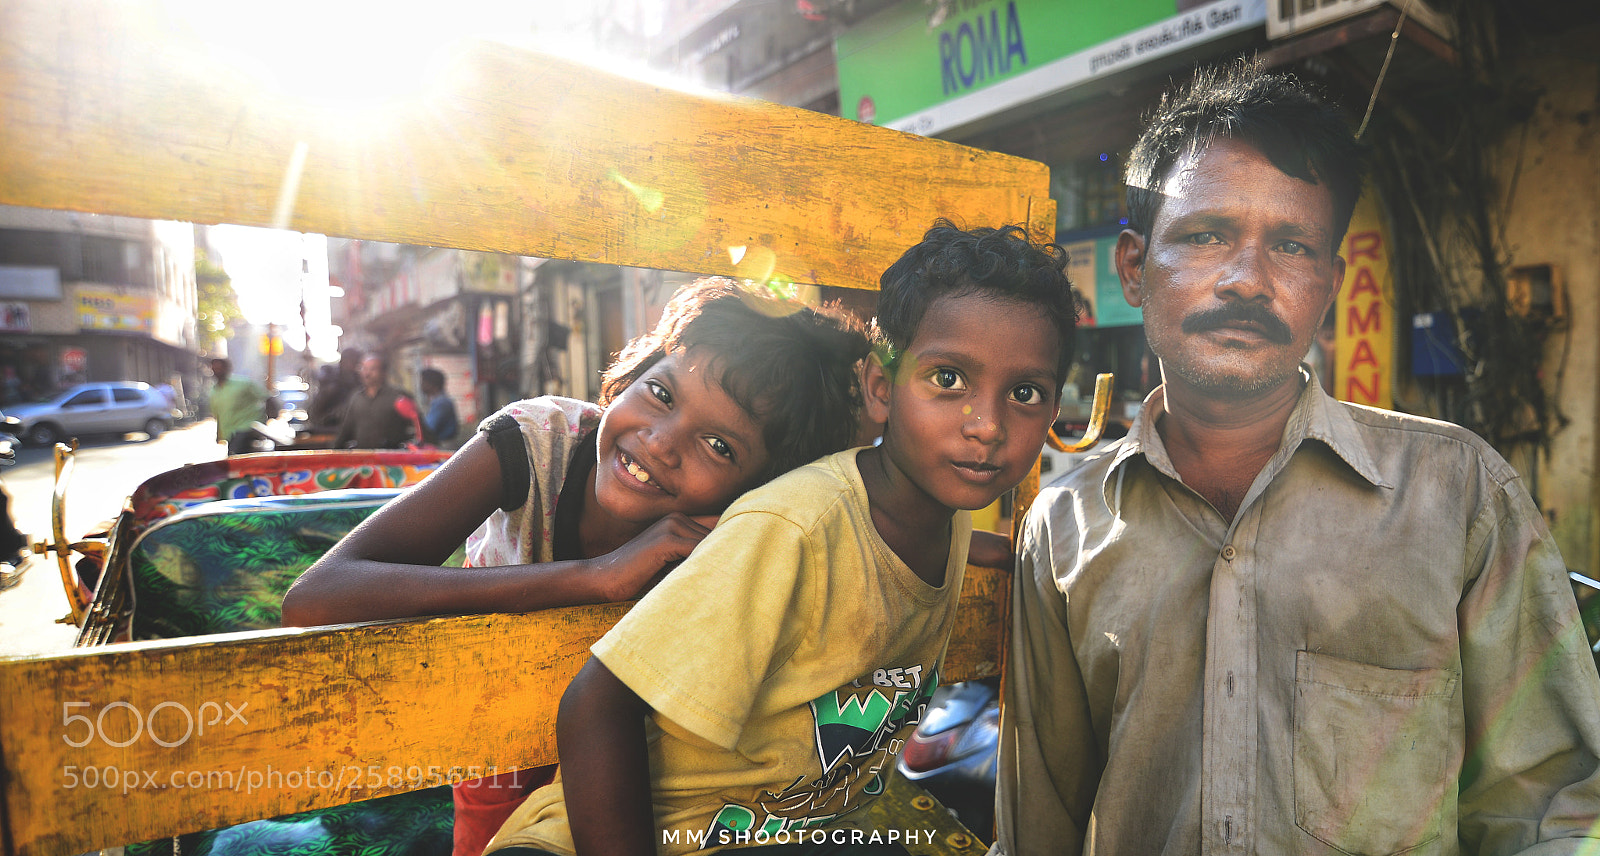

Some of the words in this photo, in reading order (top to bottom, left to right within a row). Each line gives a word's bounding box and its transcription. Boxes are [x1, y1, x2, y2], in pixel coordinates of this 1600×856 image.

[939, 1, 1028, 97] ROMA
[1346, 230, 1382, 403] RAMAN
[873, 664, 922, 689] BET
